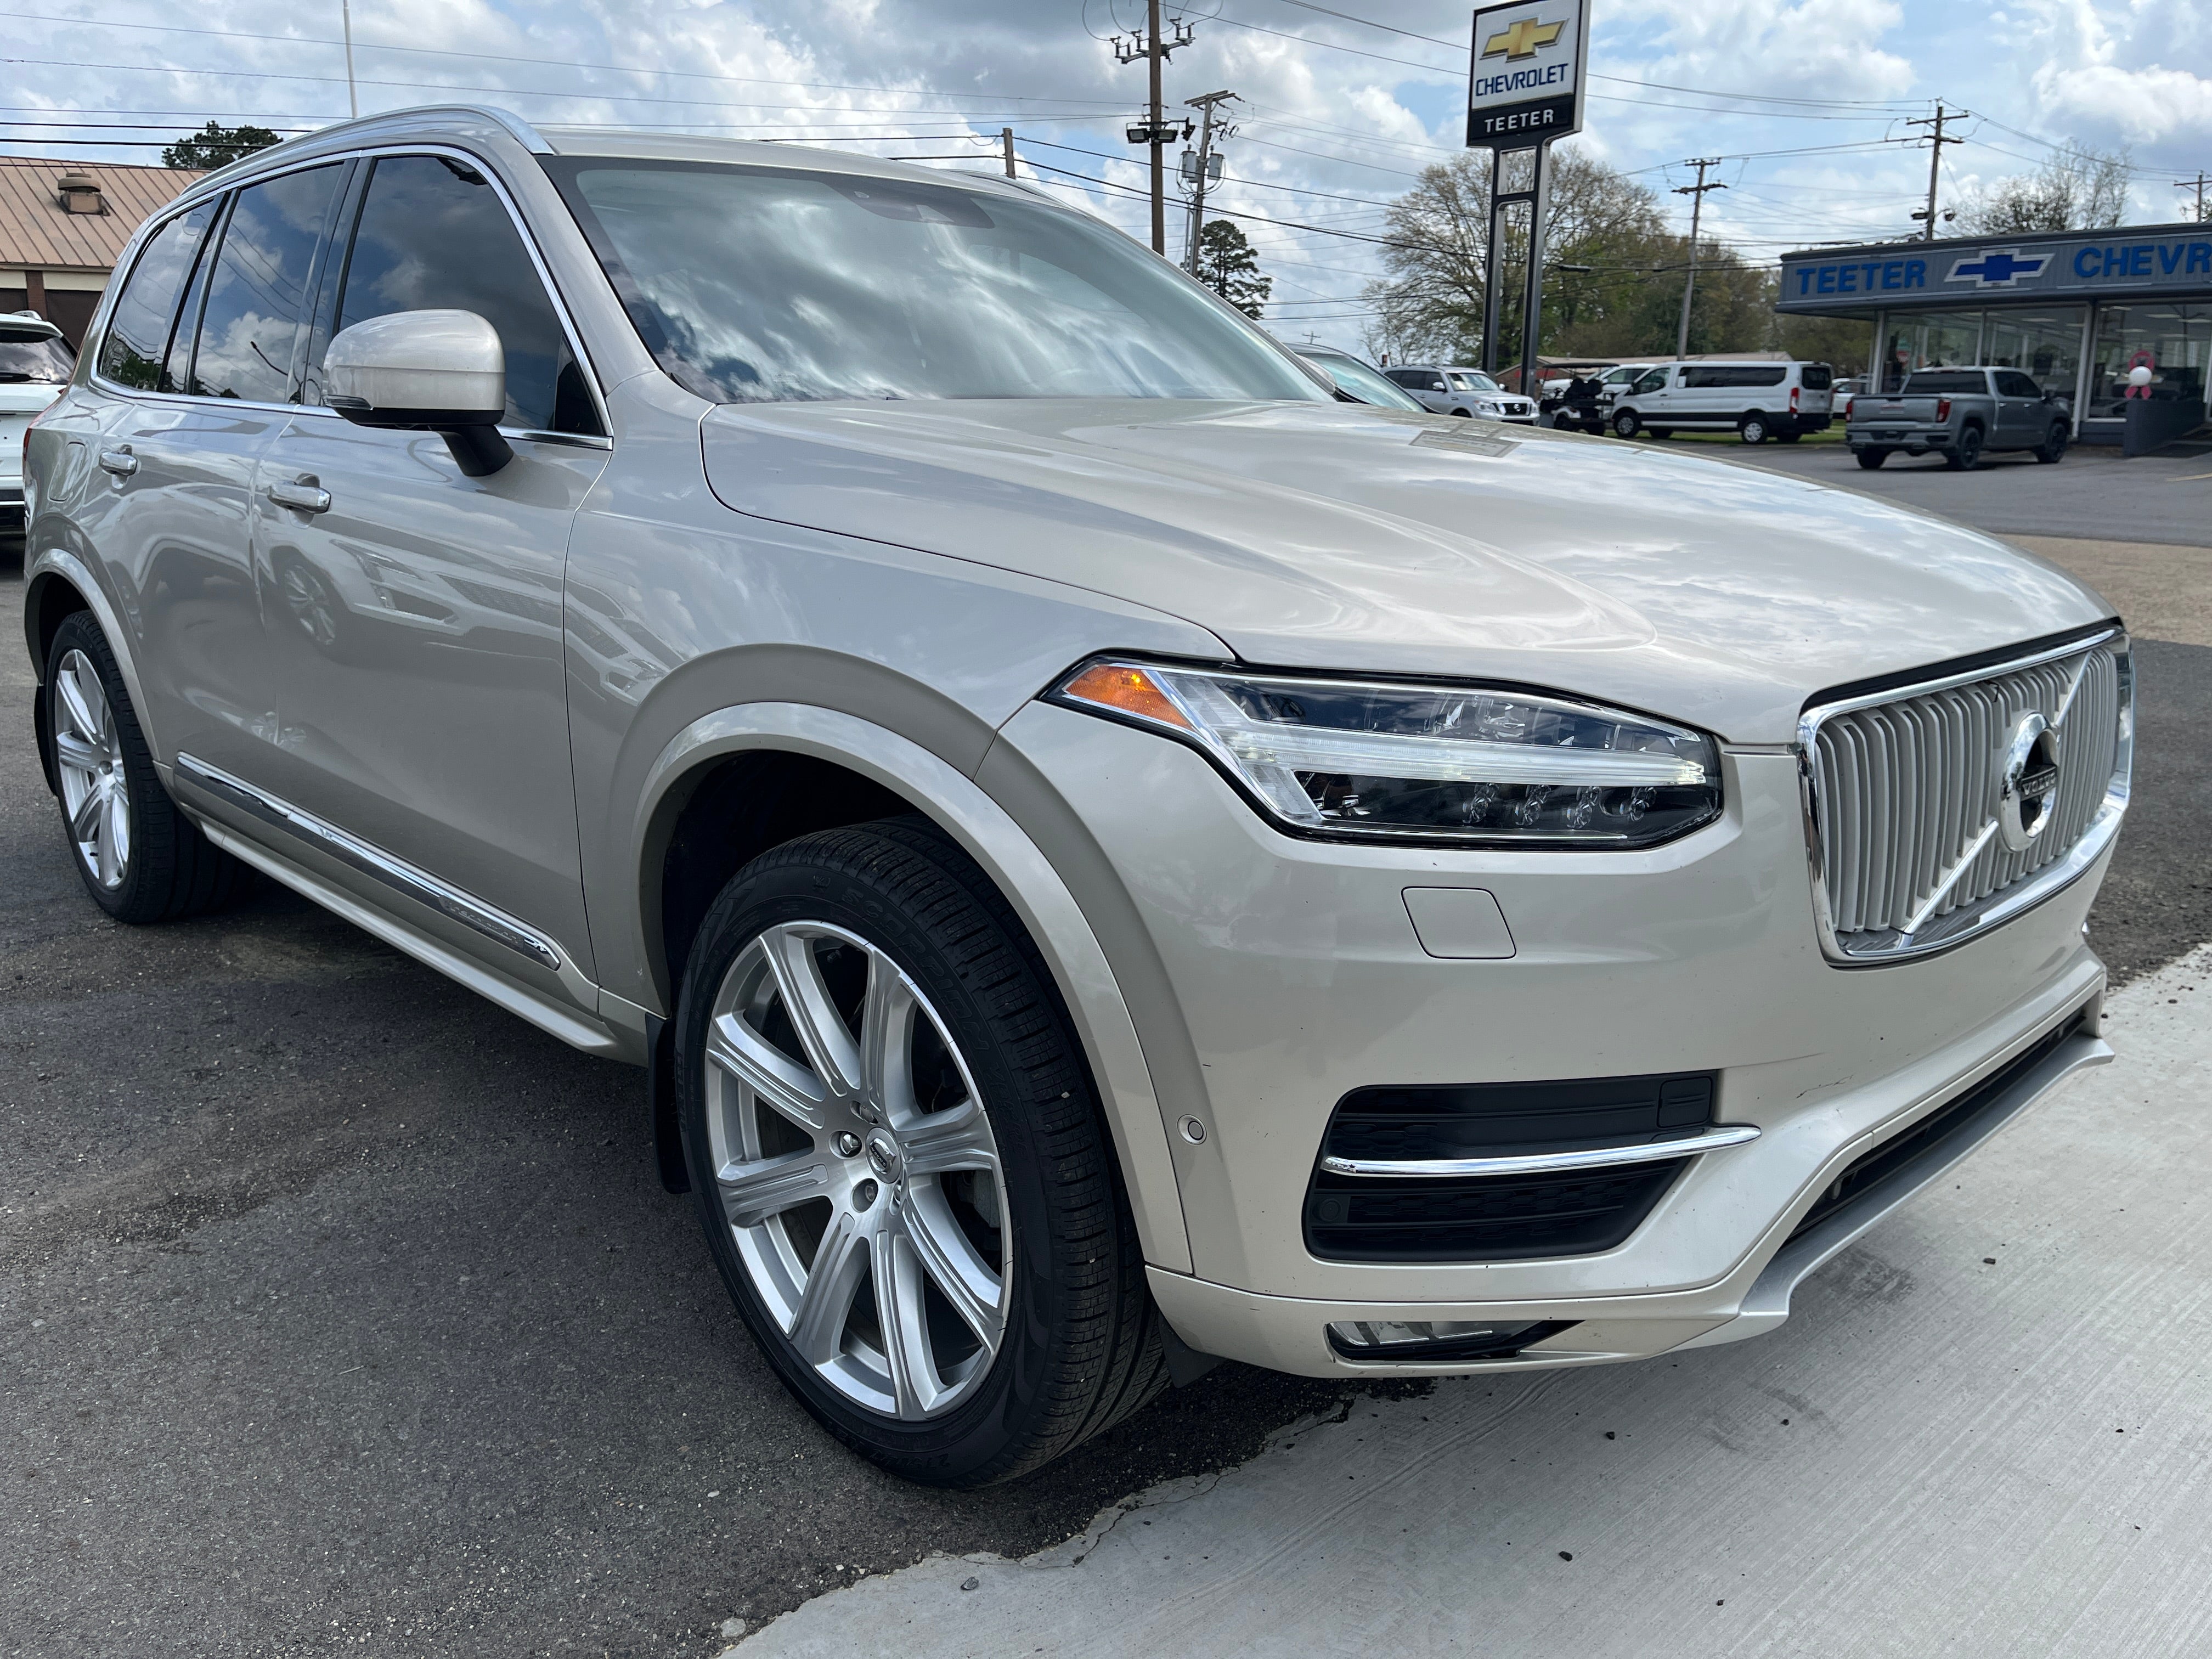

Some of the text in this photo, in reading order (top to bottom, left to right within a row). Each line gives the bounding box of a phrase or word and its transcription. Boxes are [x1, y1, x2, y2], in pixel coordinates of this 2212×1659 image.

[1475, 63, 1568, 97] CHEVROLET
[1484, 109, 1554, 133] TEETER
[1796, 242, 2212, 294] TEETER CHEVR
[841, 887, 991, 1051] SCORPION
